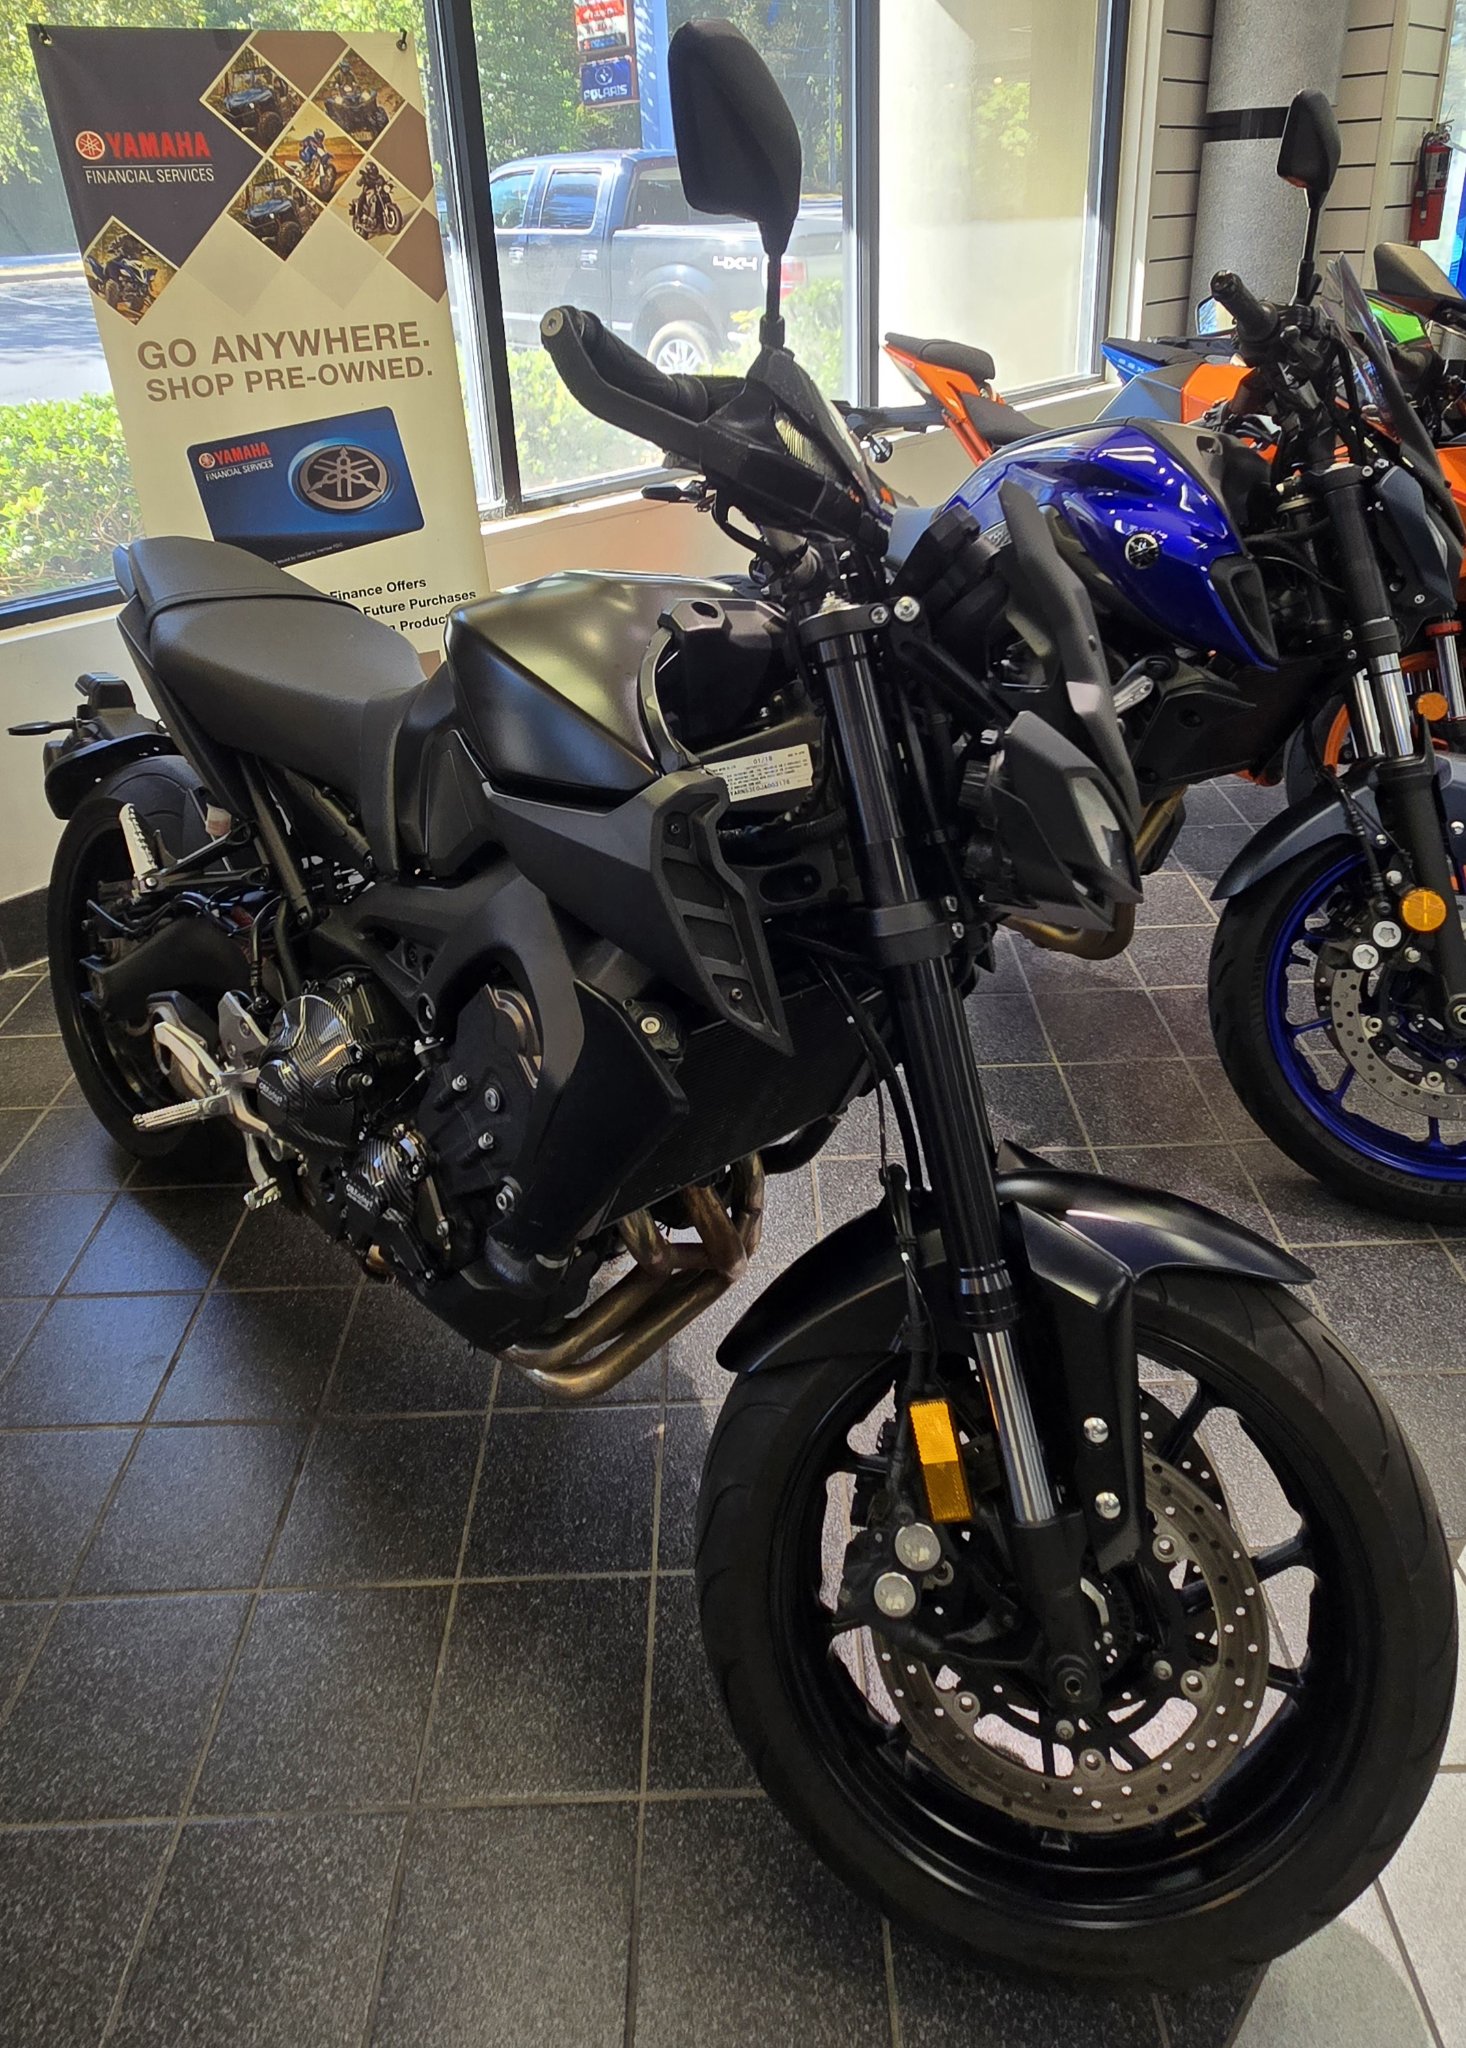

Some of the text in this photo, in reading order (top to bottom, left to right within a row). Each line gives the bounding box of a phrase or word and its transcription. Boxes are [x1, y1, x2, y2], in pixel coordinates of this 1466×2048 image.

[583, 84, 628, 101] POLARIS
[104, 131, 212, 159] YAMAHA
[85, 167, 215, 184] FINANCIAL SERVICES
[137, 320, 431, 370] GO ANYWHERE.
[145, 355, 434, 403] SHOP PRE-OWNED.
[213, 441, 271, 466] YAMAHA
[205, 459, 274, 482] FINANCIAL SERVICES
[329, 578, 427, 600] Finance Offers
[363, 590, 477, 617] Future Purchases
[400, 613, 449, 631] Produc
